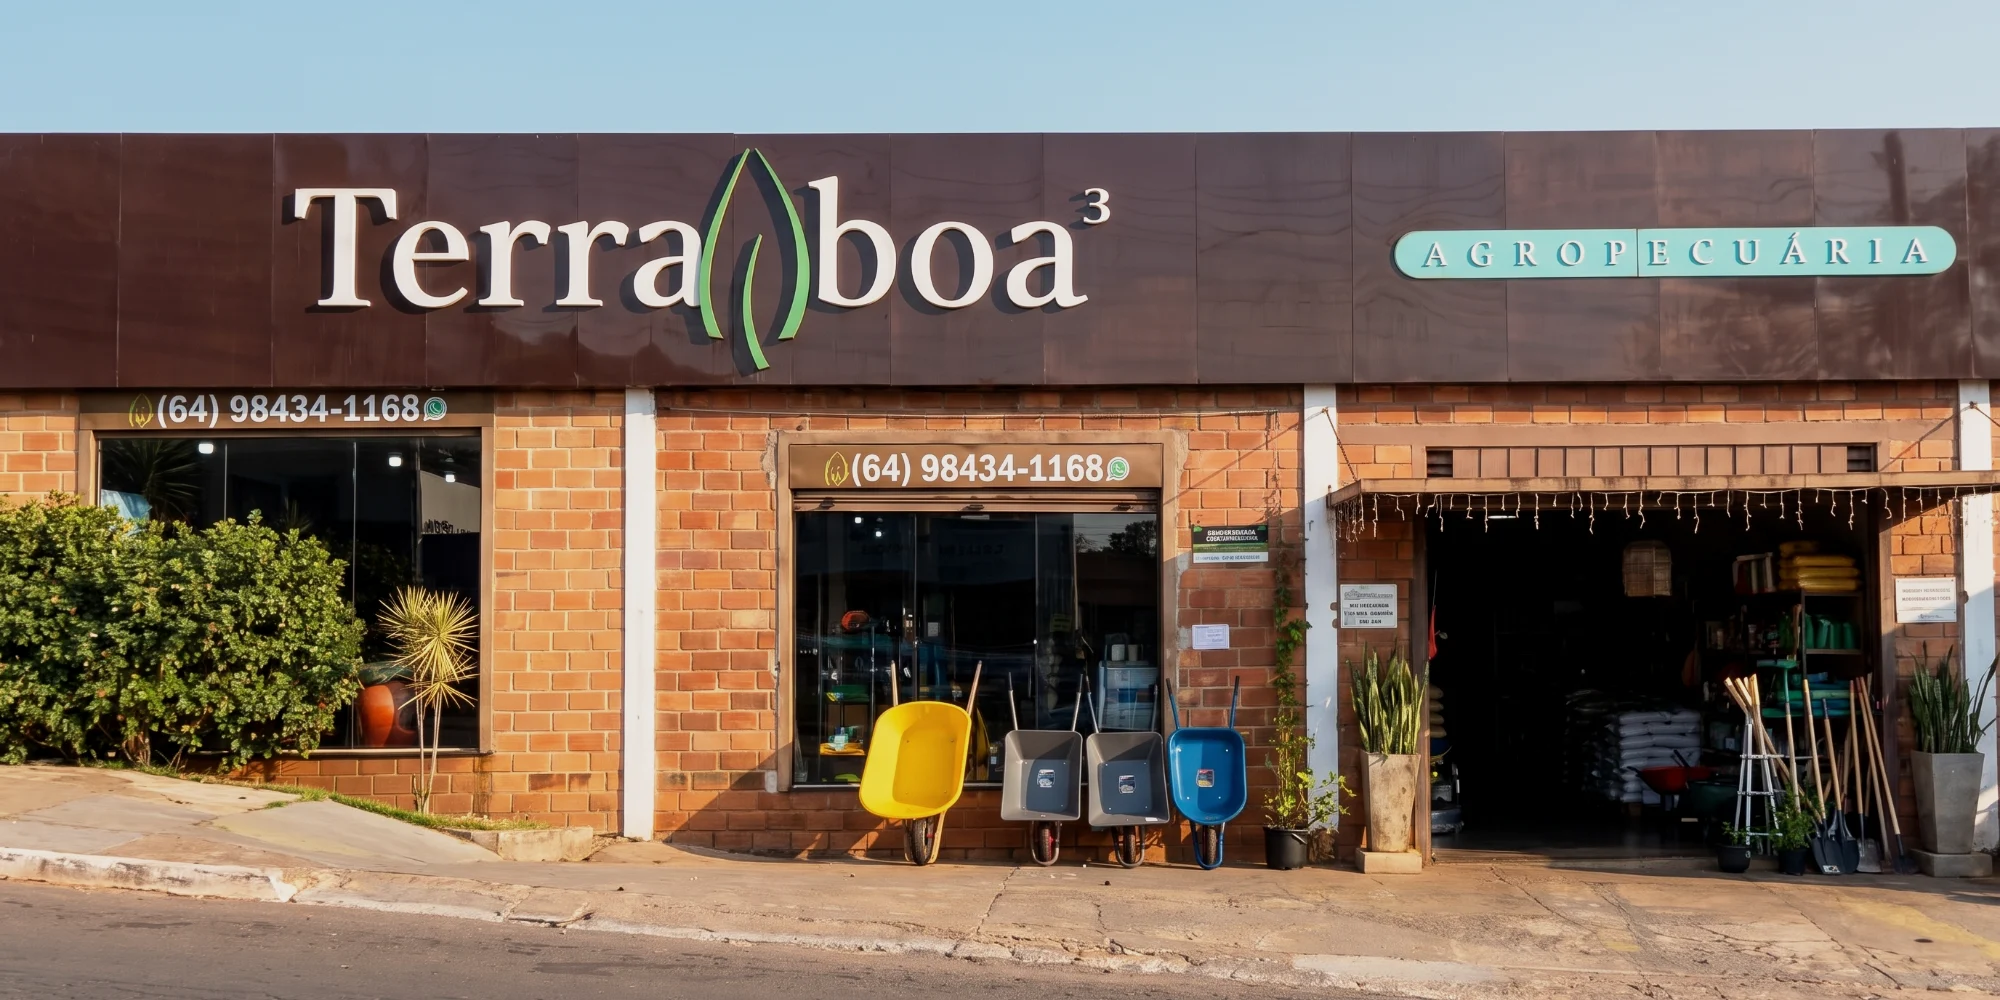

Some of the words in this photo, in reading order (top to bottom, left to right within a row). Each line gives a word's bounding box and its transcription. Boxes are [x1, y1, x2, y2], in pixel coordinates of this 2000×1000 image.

[294, 187, 702, 308] Terra
[1422, 232, 1930, 268] AGROPECUÁRIA
[157, 394, 219, 428] (64)
[230, 394, 420, 423] 98434-1168
[852, 453, 911, 487] (64)
[921, 453, 1103, 483] 98434-1168
